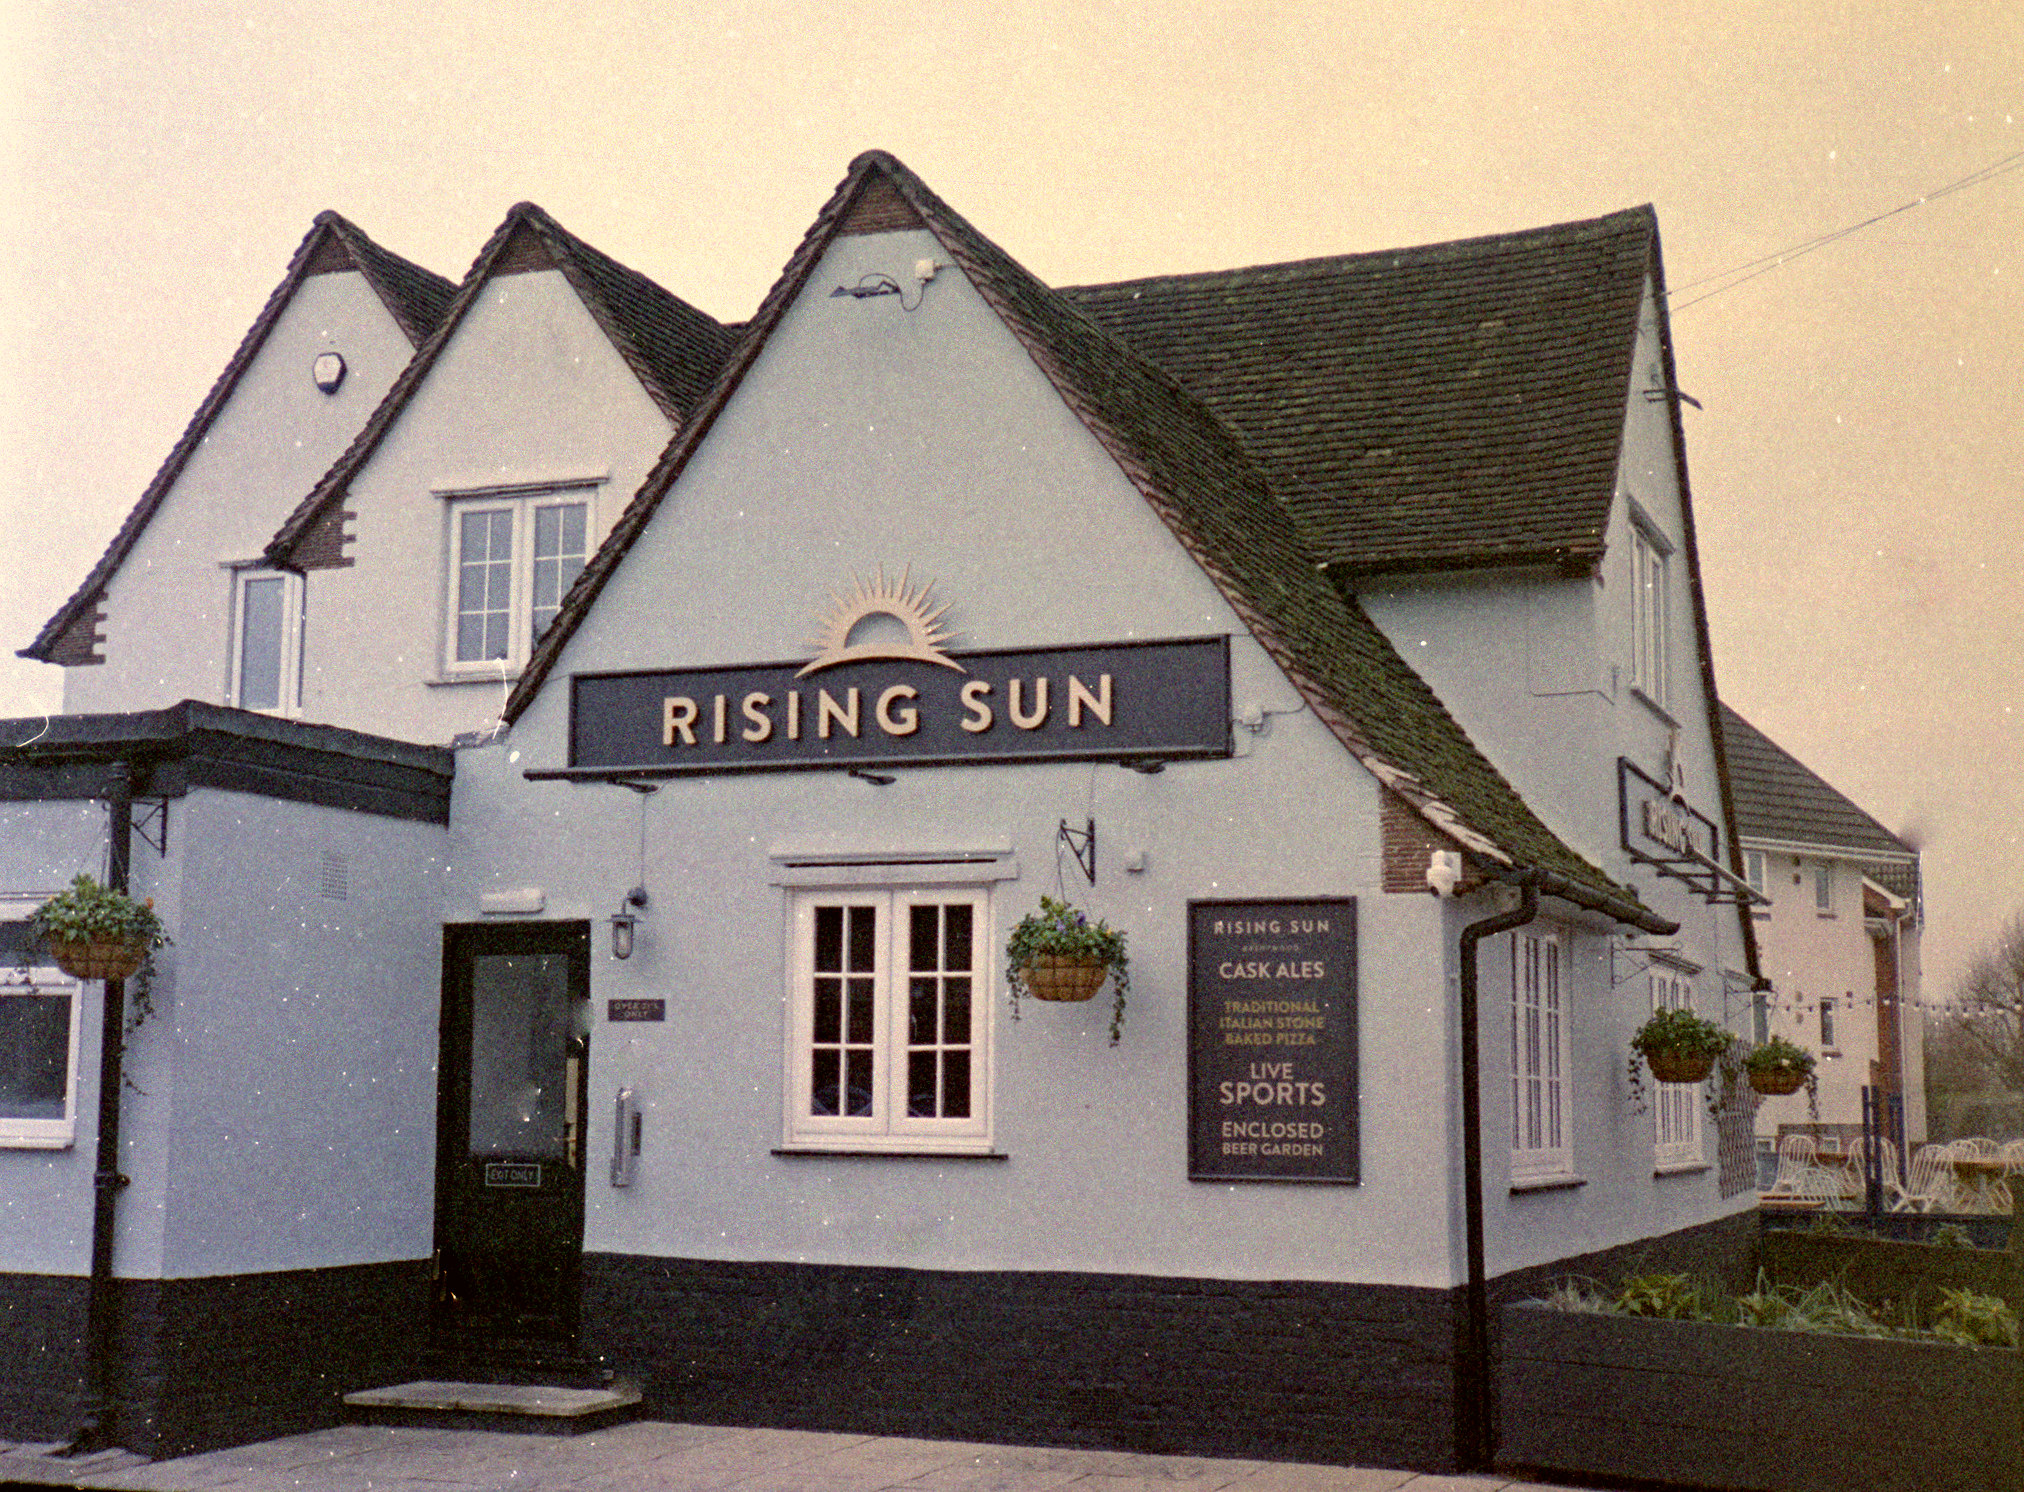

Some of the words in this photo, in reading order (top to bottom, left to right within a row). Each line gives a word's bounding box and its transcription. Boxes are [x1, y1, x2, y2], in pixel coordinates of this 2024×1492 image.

[662, 685, 918, 746] RISING
[960, 674, 1112, 732] SUN
[1214, 920, 1281, 934] RISING
[1290, 920, 1329, 933] SUN
[1219, 962, 1271, 979] CASK
[1276, 962, 1325, 979] ALES
[1224, 1001, 1320, 1014] TRADITIONAL
[1219, 1017, 1272, 1029] ITALIAN
[1276, 1016, 1325, 1029] STONE
[1225, 1033, 1272, 1046] BAKED
[1276, 1033, 1316, 1045] PIZZA
[1250, 1062, 1294, 1080] LIVE
[1219, 1082, 1326, 1106] SPORTS
[1221, 1121, 1324, 1139] ENCLOSED
[1222, 1143, 1257, 1156] BEER
[1260, 1143, 1323, 1157] GARDEN
